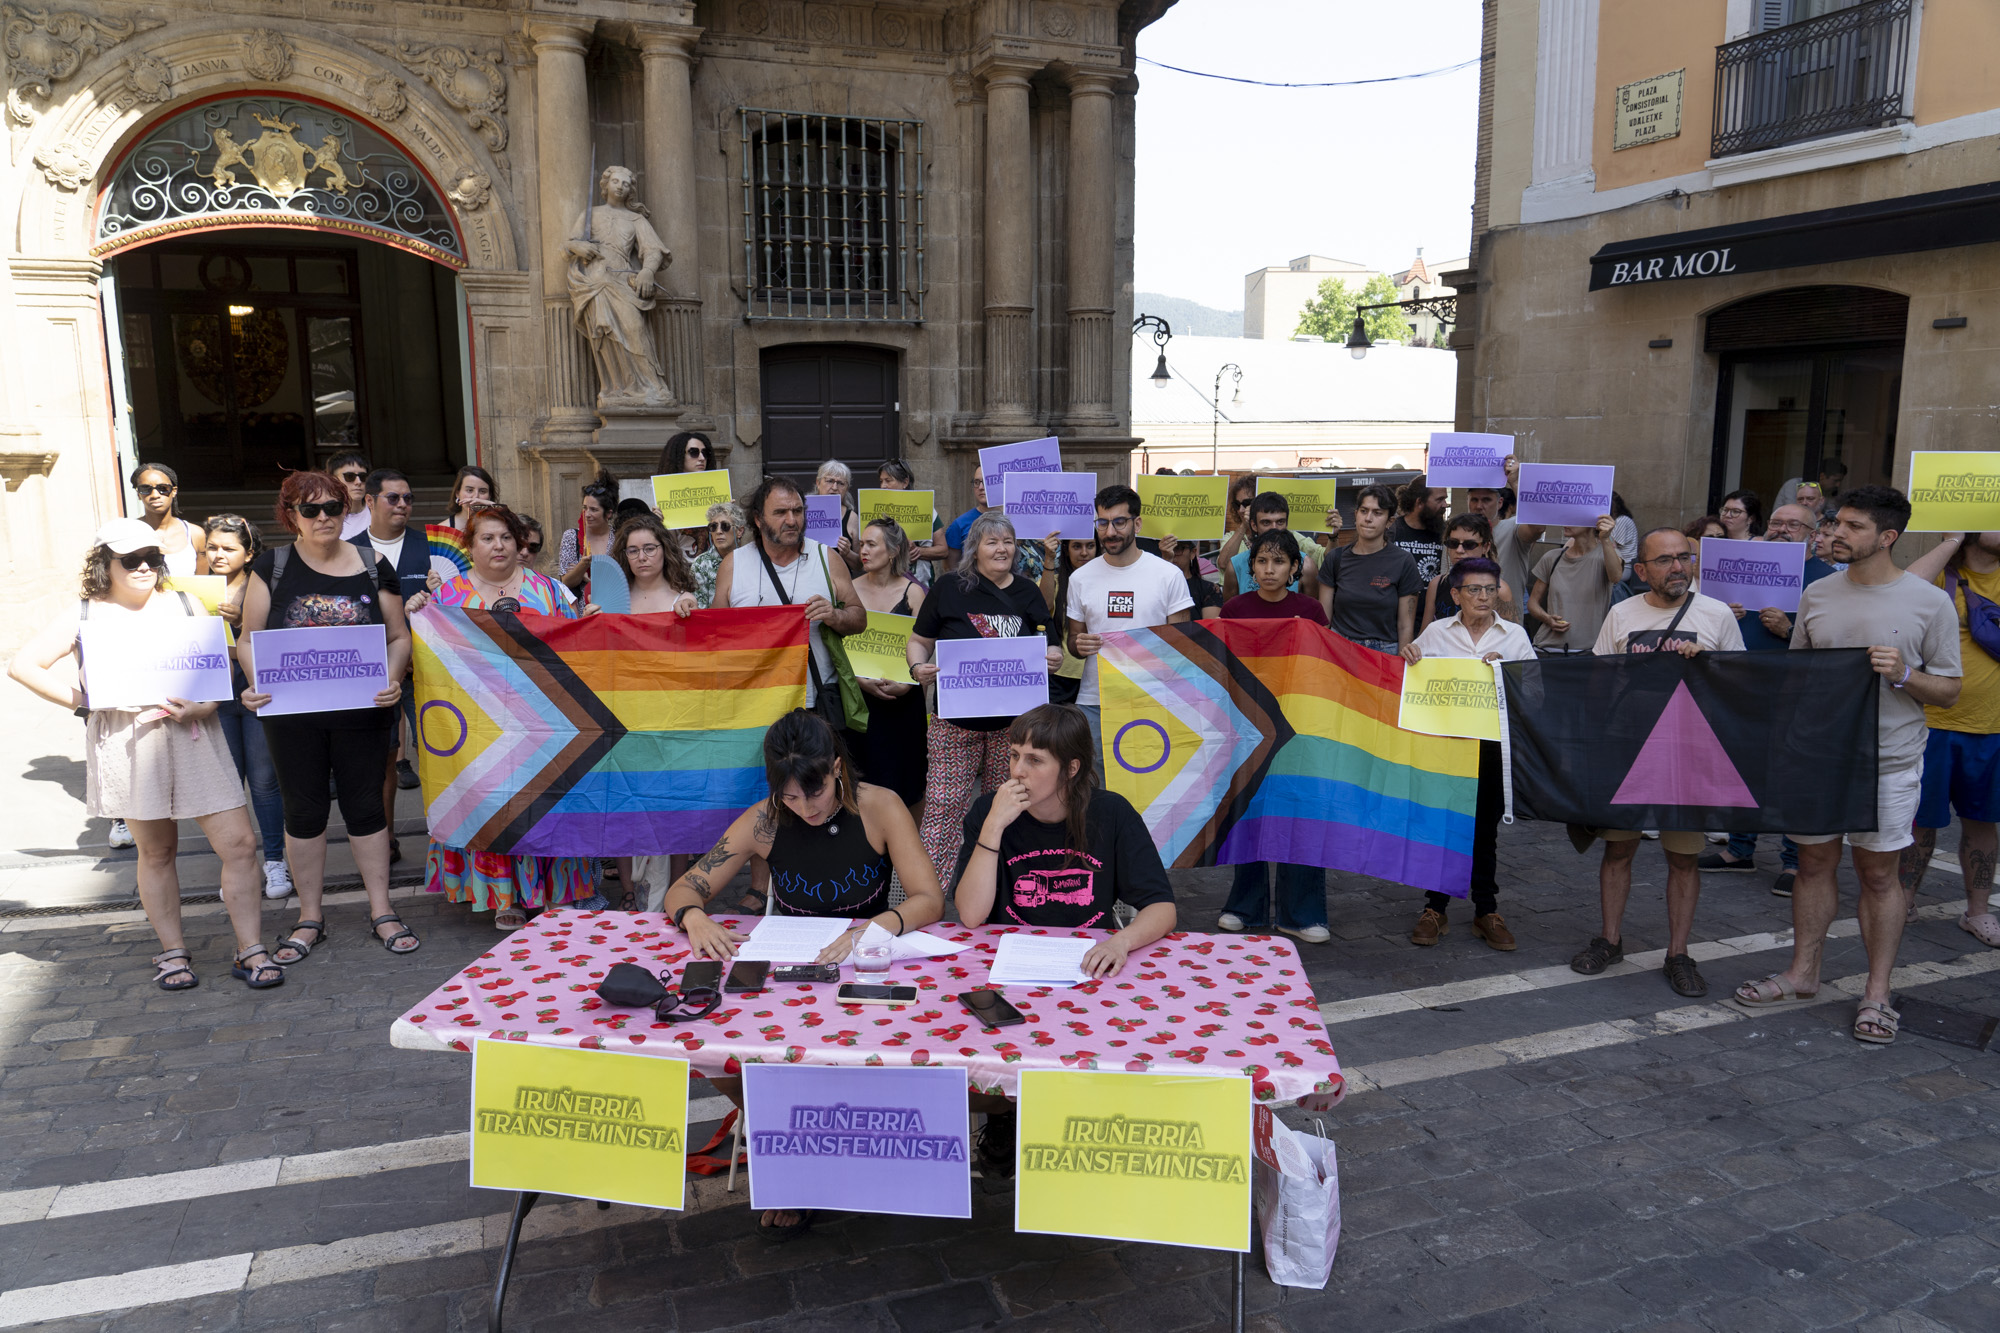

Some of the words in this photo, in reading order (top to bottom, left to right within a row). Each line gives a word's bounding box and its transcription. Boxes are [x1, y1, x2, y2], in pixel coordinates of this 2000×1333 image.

[1638, 86, 1657, 98] PLAZA
[1626, 95, 1669, 113] CONSISTORIAL
[1629, 112, 1663, 127] UDALETXE
[1635, 125, 1656, 137] PLAZA
[182, 58, 230, 76] JANVA
[313, 65, 344, 85] COR
[412, 123, 448, 162] VALDE
[473, 217, 493, 262] MAGIS
[1609, 257, 1664, 285] BAR
[1669, 248, 1736, 278] MOL
[1445, 446, 1496, 457] IRUÑERRIA
[1430, 457, 1505, 467] TRANSFEMINIST
[1537, 481, 1593, 494] IRUÑERRIA
[1938, 473, 2000, 488] IRUÑERR
[671, 486, 716, 499] IRUÑERRIA
[1023, 490, 1078, 503] IRUÑERRIA
[1154, 494, 1209, 505] IRUÑERRIA
[1286, 494, 1320, 504] ÑERRIA
[1520, 492, 1609, 506] TRANSFEMINISTA
[1913, 490, 2000, 503] TRANSFEMI
[874, 503, 919, 514] IRUÑERRIA
[1007, 504, 1094, 515] TRANSFEMINISTA
[1141, 505, 1224, 517] TRANSFEMINISTA
[1289, 504, 1334, 513] FEMINISTA
[807, 519, 840, 529] MINISTA
[1719, 558, 1781, 574] IRUÑERRIA
[1703, 570, 1801, 587] TRANSFEMINISTA
[1109, 596, 1133, 605] FCK
[1108, 604, 1133, 613] TERF
[282, 650, 361, 667] IRUÑERRIA
[259, 664, 386, 684] TRANSFEMINISTA
[961, 659, 1025, 675] IRUÑERRIA
[941, 674, 1046, 689] TRANSFEMINISTA
[1405, 692, 1498, 710] TRANSFEMINIS
[1006, 850, 1040, 866] TRANS
[518, 1089, 643, 1121] IRUÑERRIA
[794, 1106, 923, 1132] IRUÑERRIA
[480, 1112, 681, 1151] TRANSFEMINISTA
[1067, 1118, 1203, 1149] IRUÑERRIA
[757, 1135, 964, 1160] TRANSFEMINISTA
[1026, 1148, 1245, 1183] TRANSFEMINISTA
